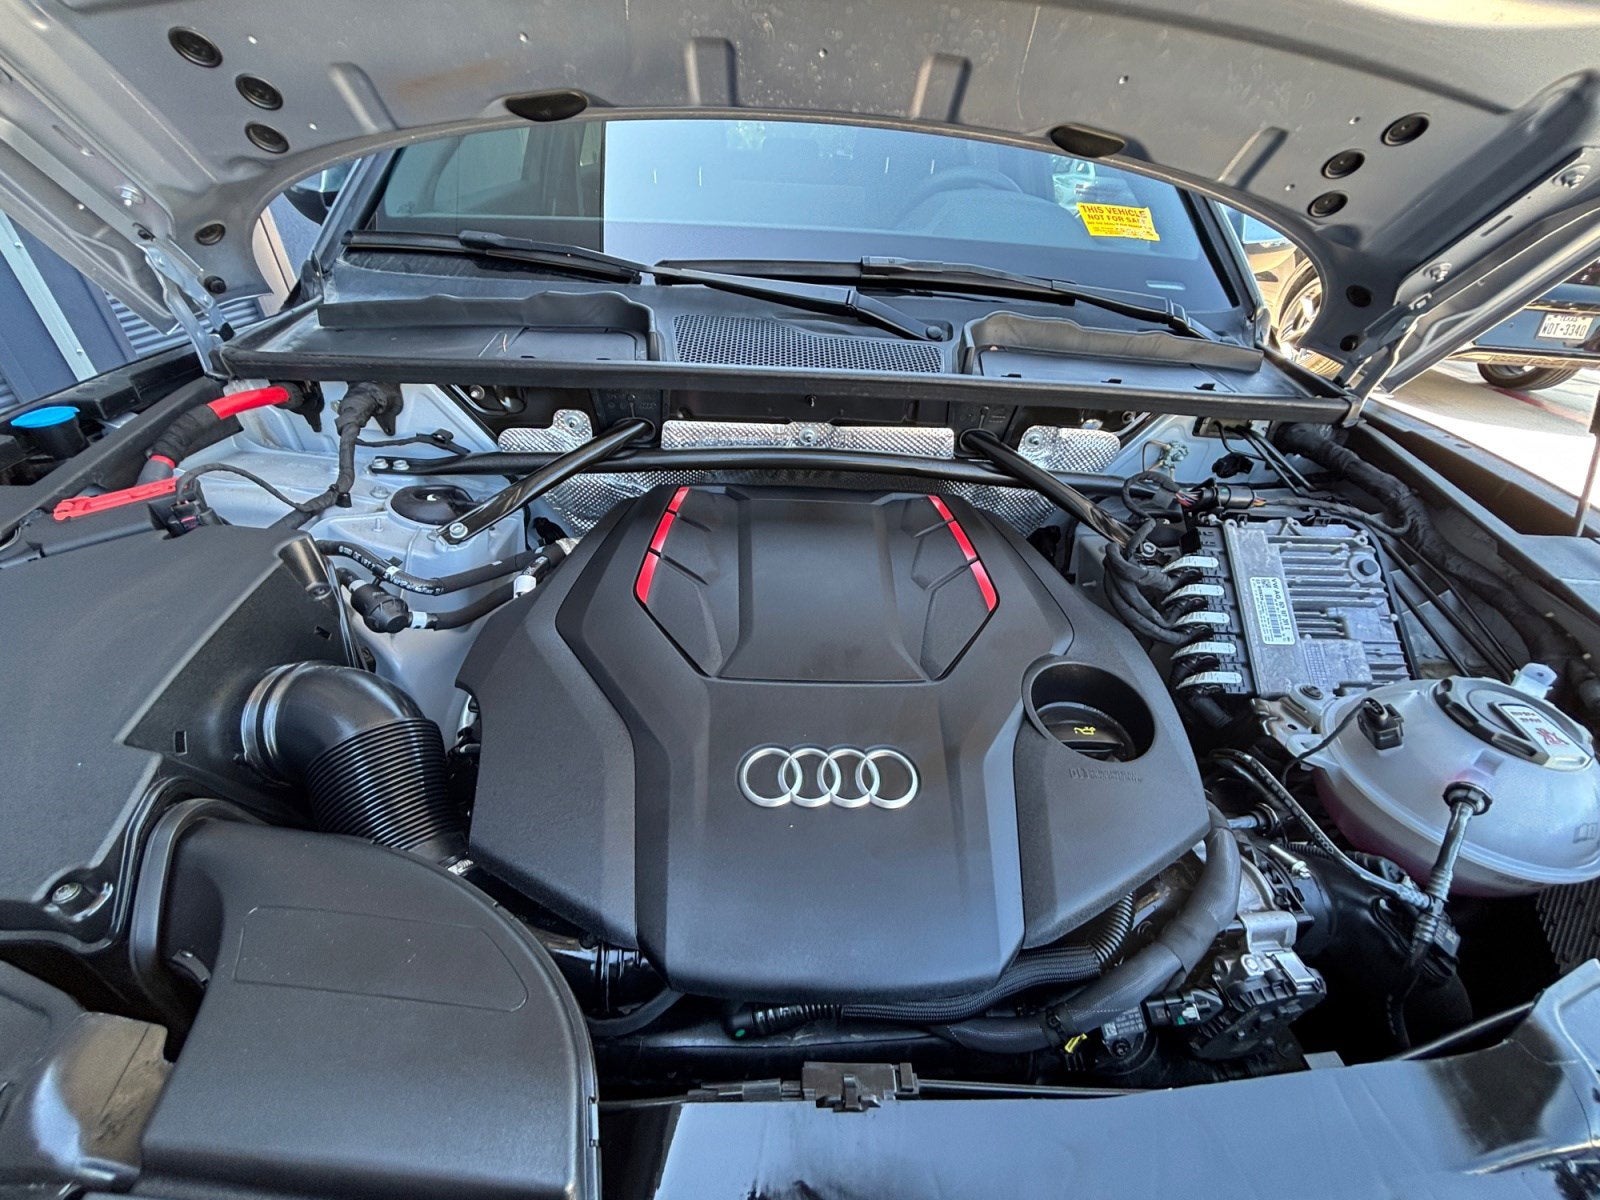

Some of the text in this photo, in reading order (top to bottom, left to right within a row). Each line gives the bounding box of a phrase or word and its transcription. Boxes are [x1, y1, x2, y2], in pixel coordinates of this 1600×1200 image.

[1081, 205, 1147, 218] THIS VEHICLE
[1271, 578, 1279, 589] VW
